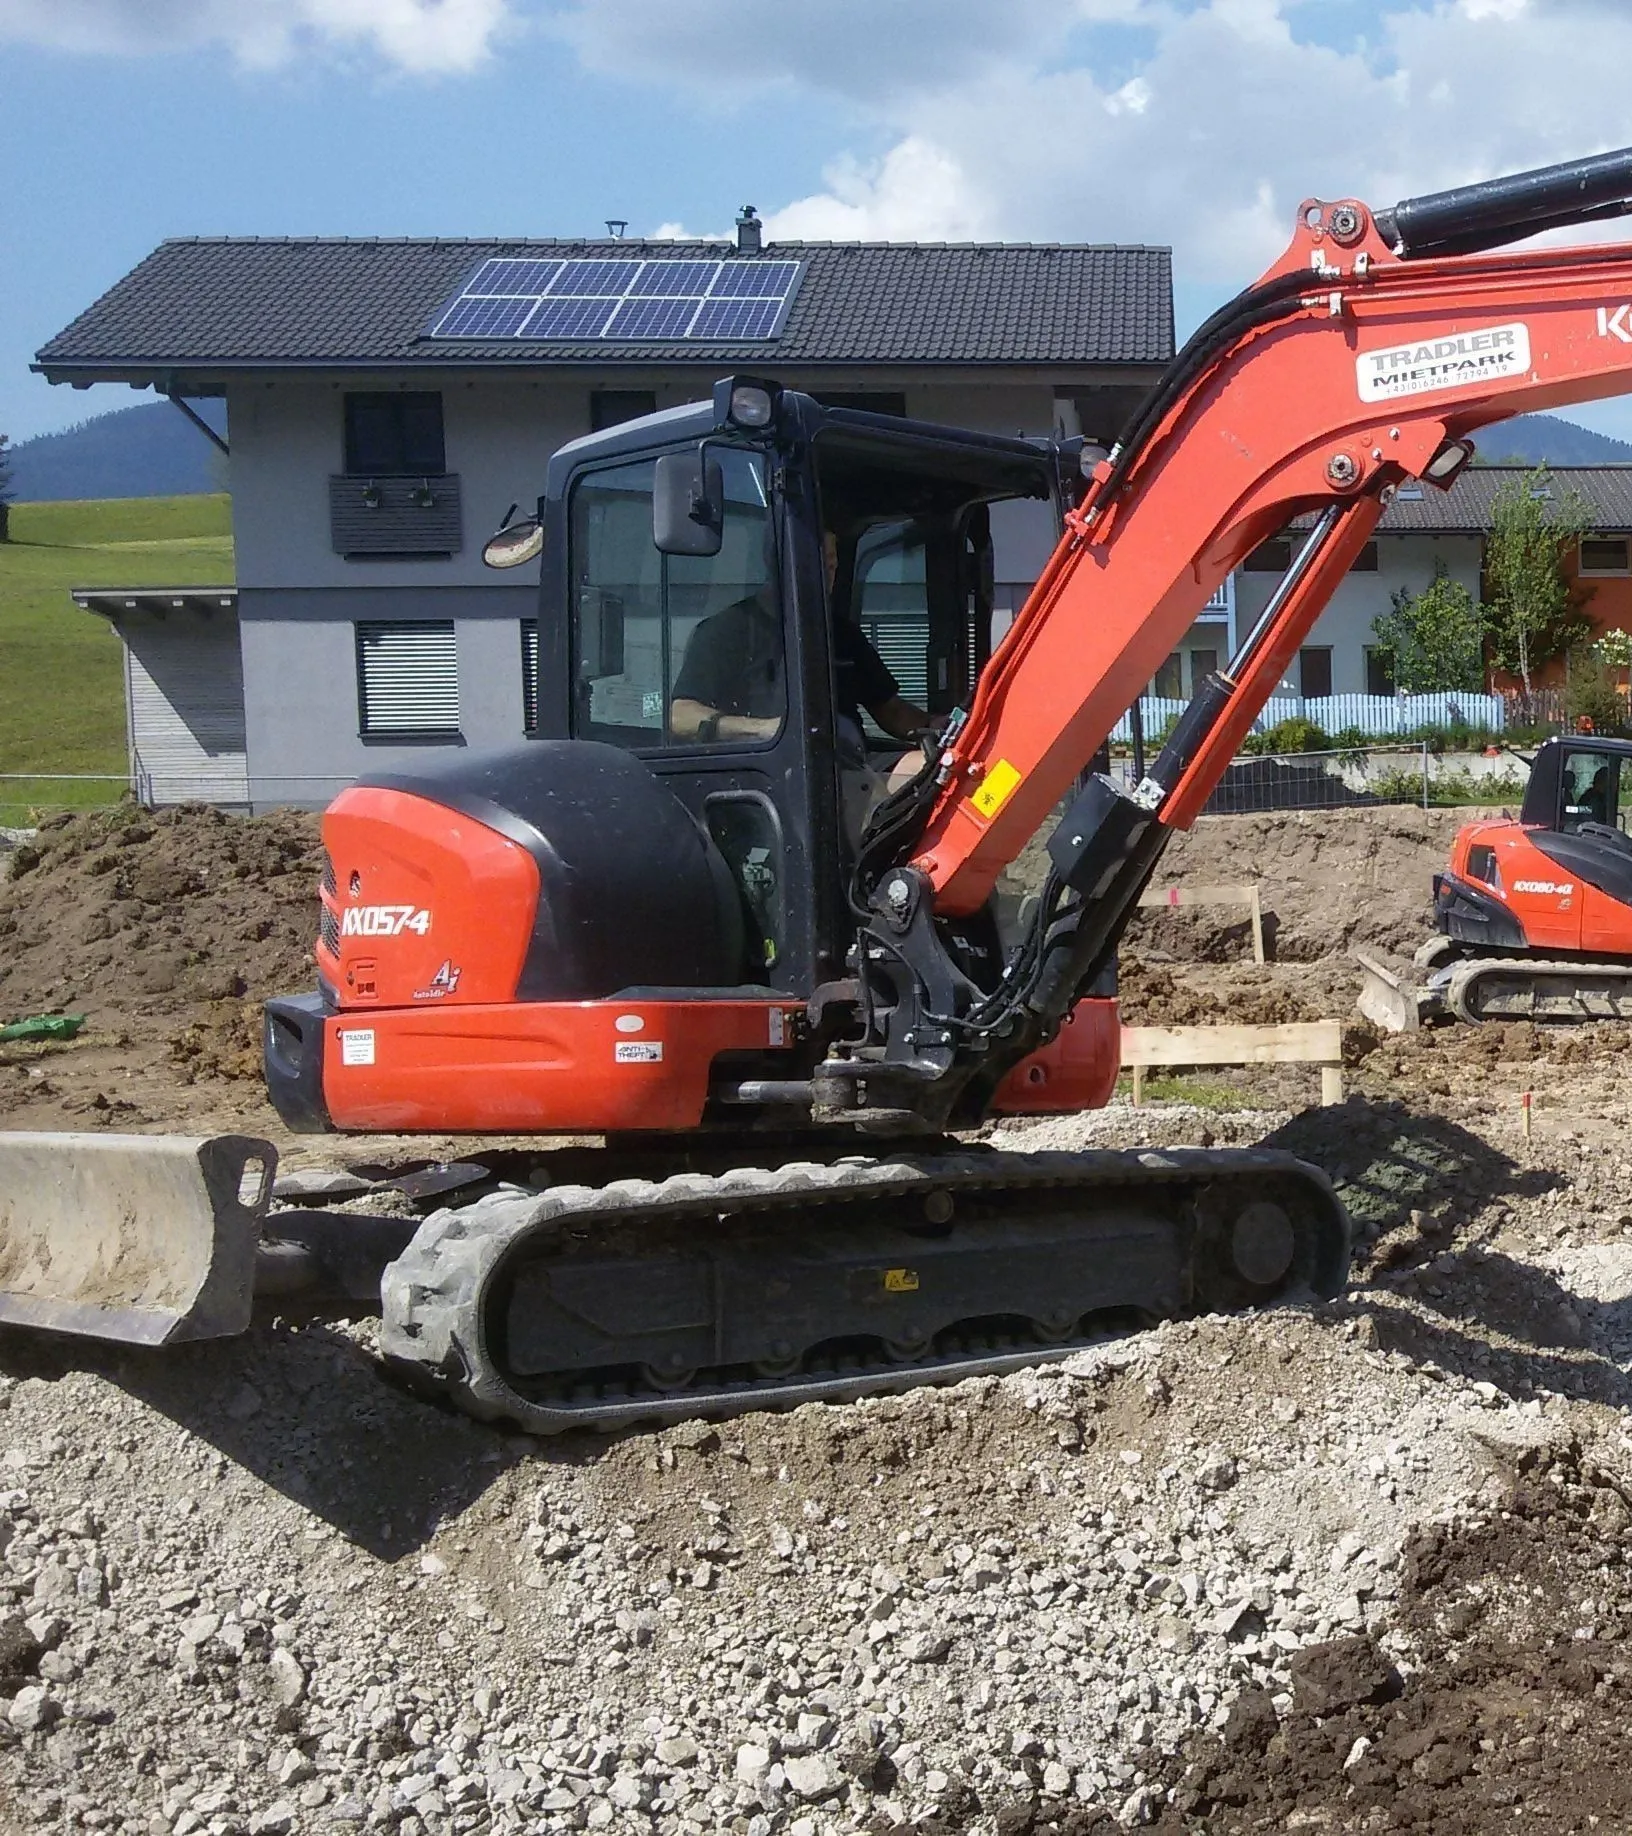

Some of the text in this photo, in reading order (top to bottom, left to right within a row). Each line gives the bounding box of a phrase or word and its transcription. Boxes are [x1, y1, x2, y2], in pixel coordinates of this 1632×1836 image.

[1370, 330, 1515, 371] TRADLER
[1373, 351, 1517, 387] MIETPARK
[341, 905, 431, 937] KX057-4
